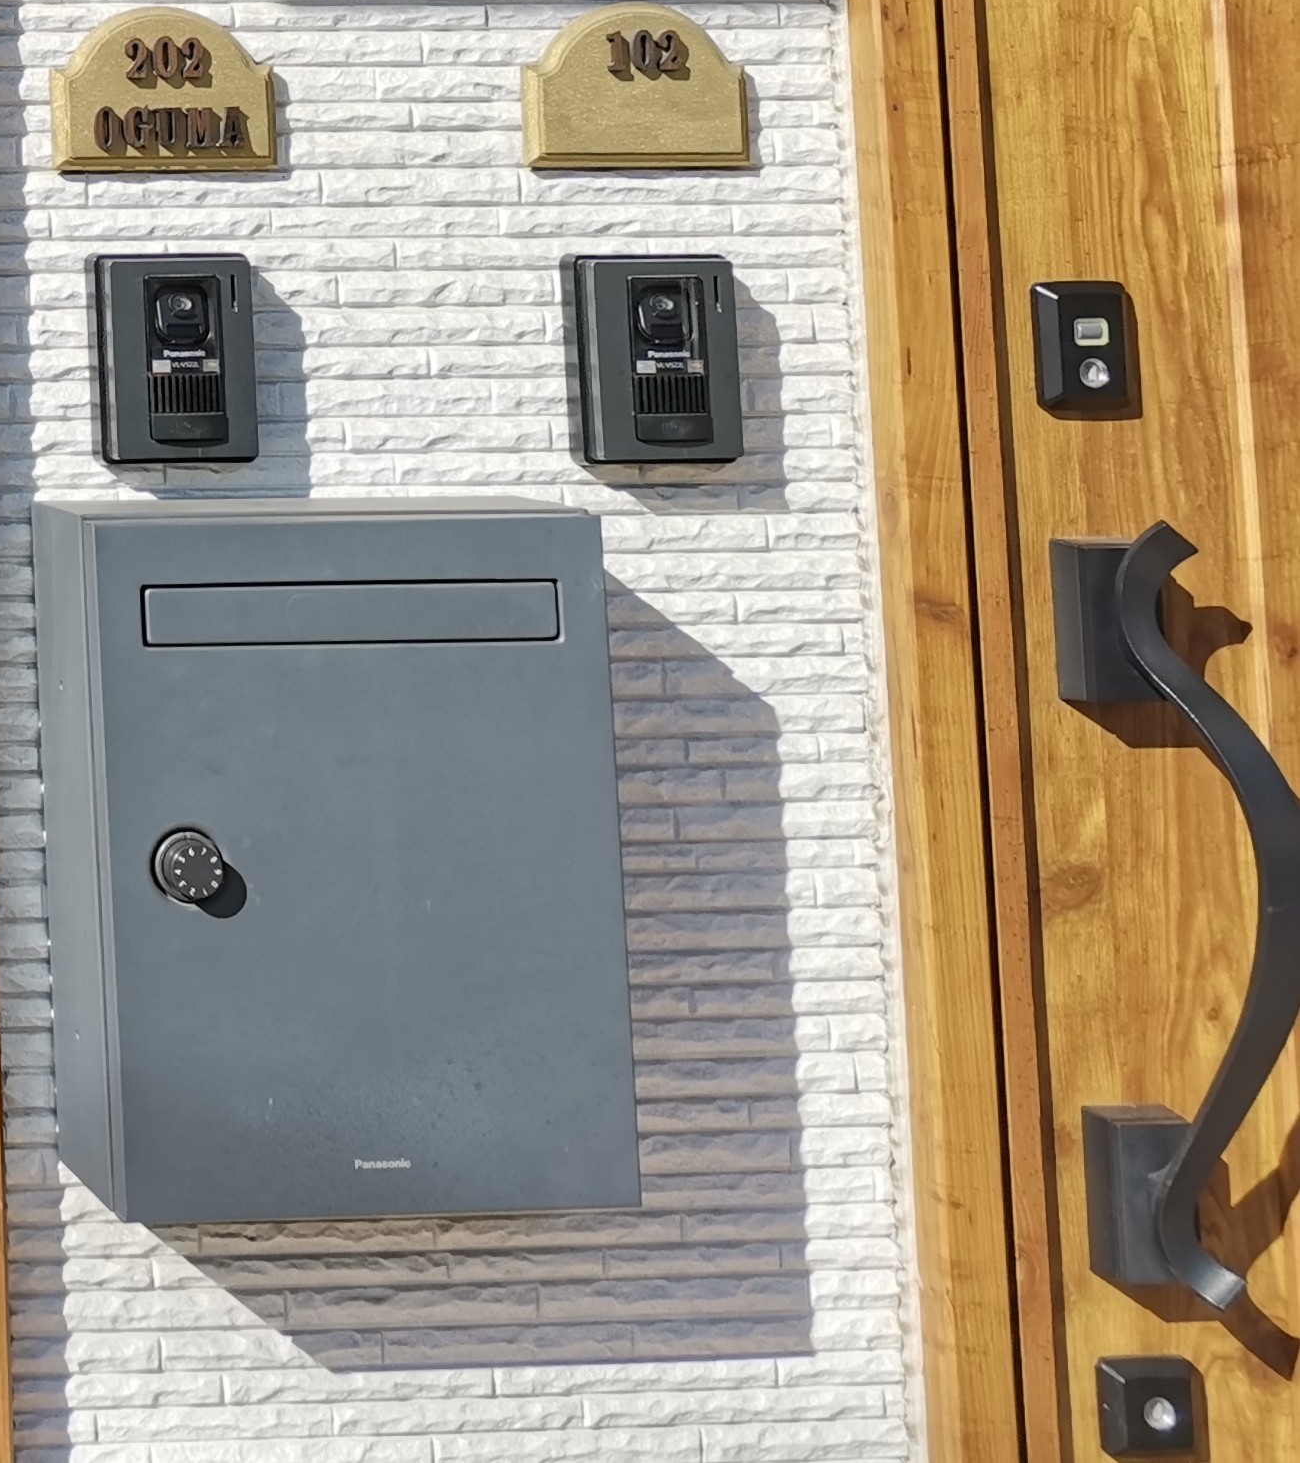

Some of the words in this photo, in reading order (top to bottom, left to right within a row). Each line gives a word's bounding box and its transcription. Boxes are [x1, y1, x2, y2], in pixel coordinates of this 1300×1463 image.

[124, 36, 205, 79] 202
[606, 30, 682, 72] 102
[94, 105, 246, 149] OGUMA
[354, 1158, 412, 1170] Panasonic
